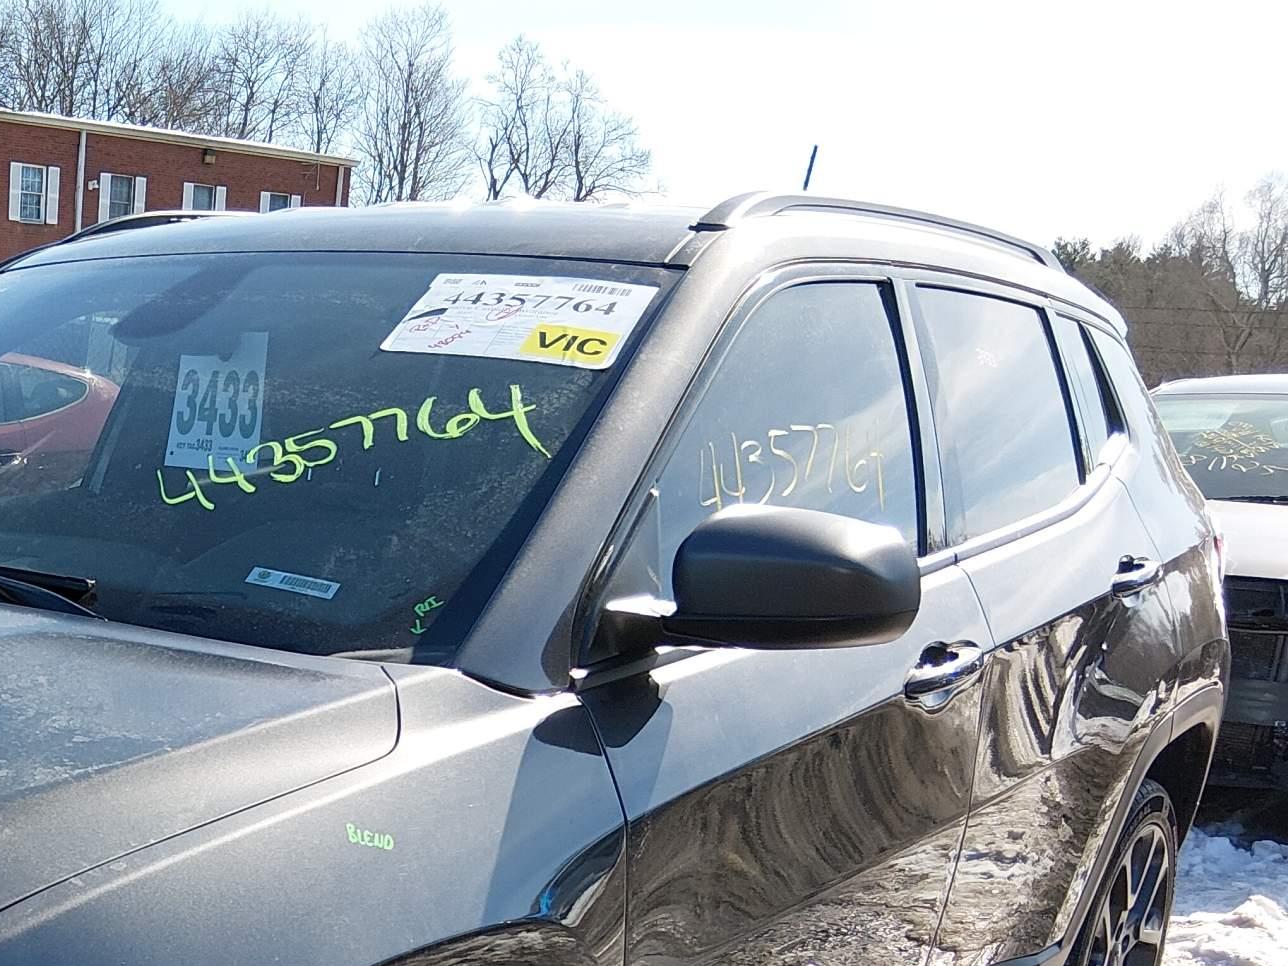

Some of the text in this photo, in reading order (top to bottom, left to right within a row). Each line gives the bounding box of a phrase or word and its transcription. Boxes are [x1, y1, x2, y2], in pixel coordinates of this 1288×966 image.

[443, 289, 617, 316] 44357764
[538, 331, 607, 356] VIC
[176, 369, 260, 438] 3433
[157, 384, 551, 510] 44357764
[344, 821, 394, 850] BLEND
